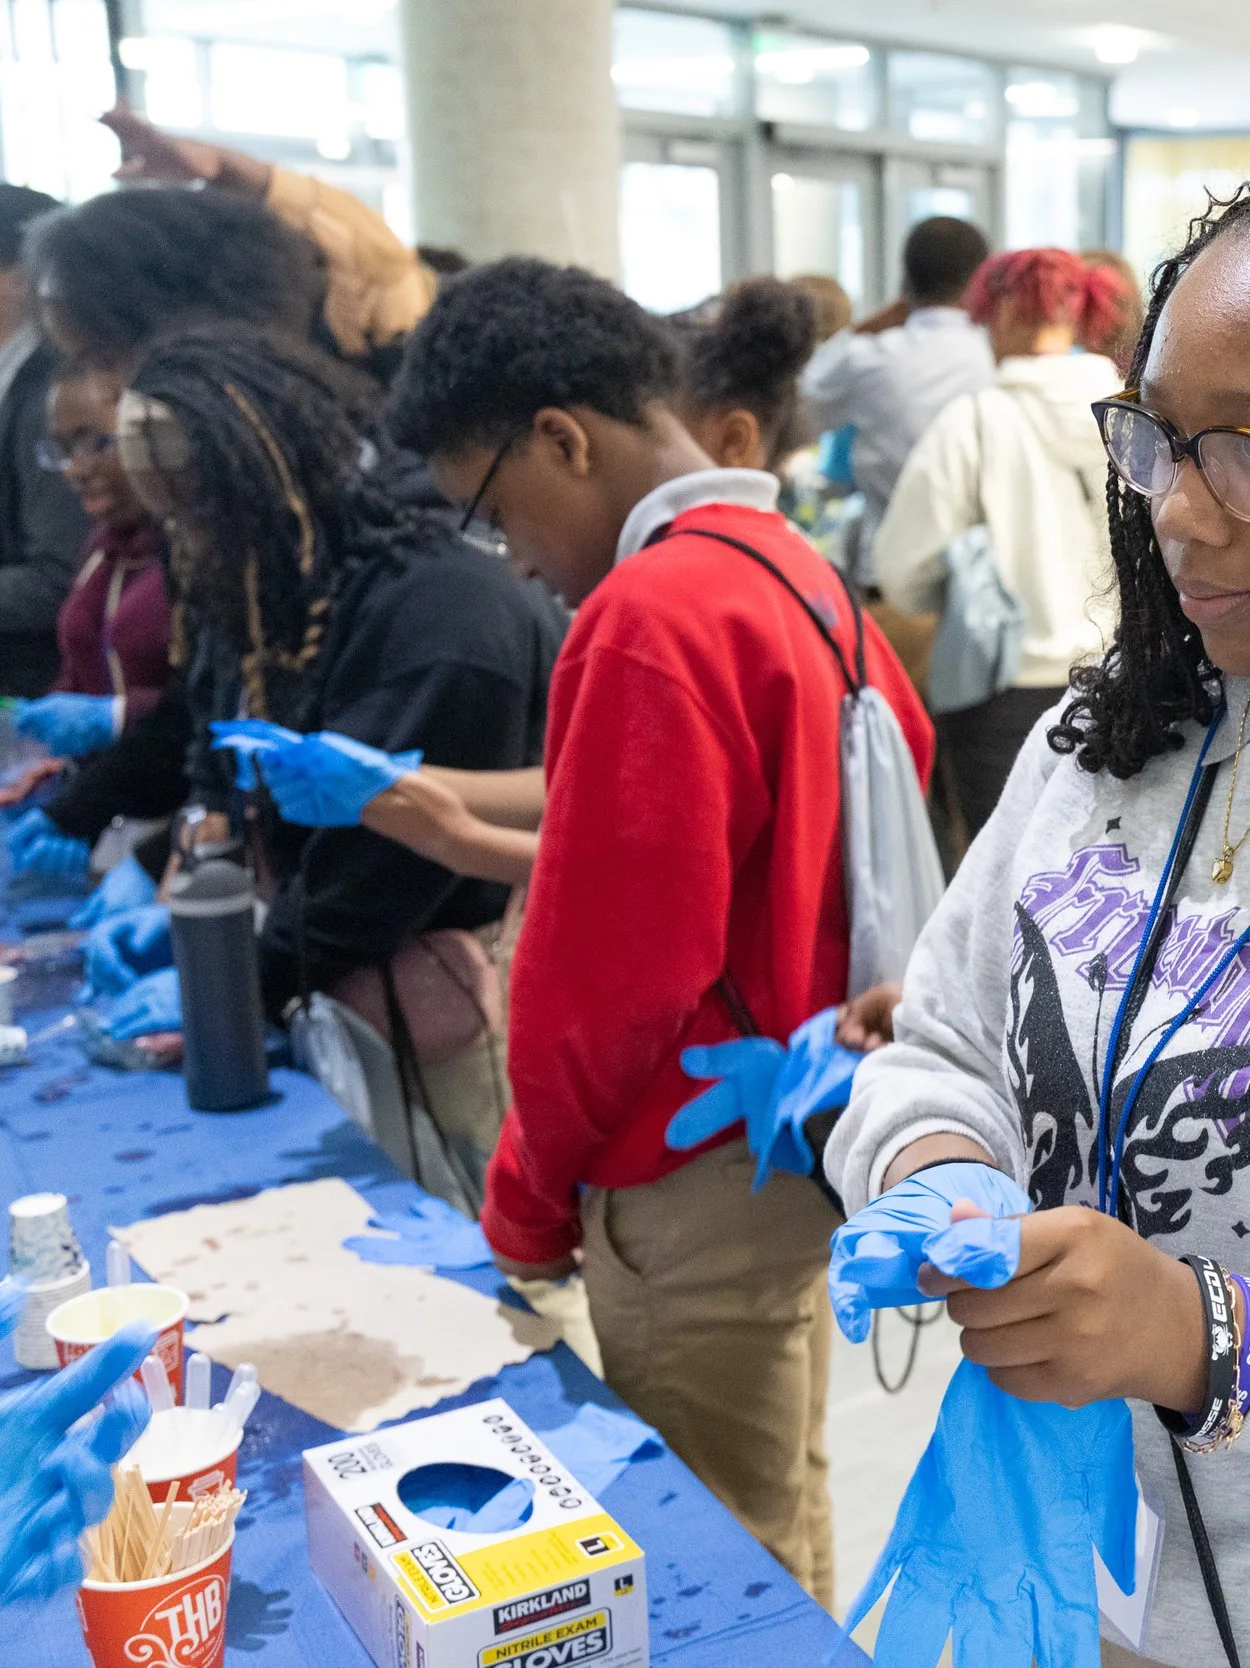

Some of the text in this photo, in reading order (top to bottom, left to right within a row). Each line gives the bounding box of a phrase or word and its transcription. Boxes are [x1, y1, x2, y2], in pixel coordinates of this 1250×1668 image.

[412, 1542, 471, 1601] GLOVES
[154, 1579, 222, 1643] THB
[498, 1582, 588, 1624] KIRKLAND
[490, 1631, 604, 1668] OVES
[496, 1617, 598, 1660] NITRILE EXAM
